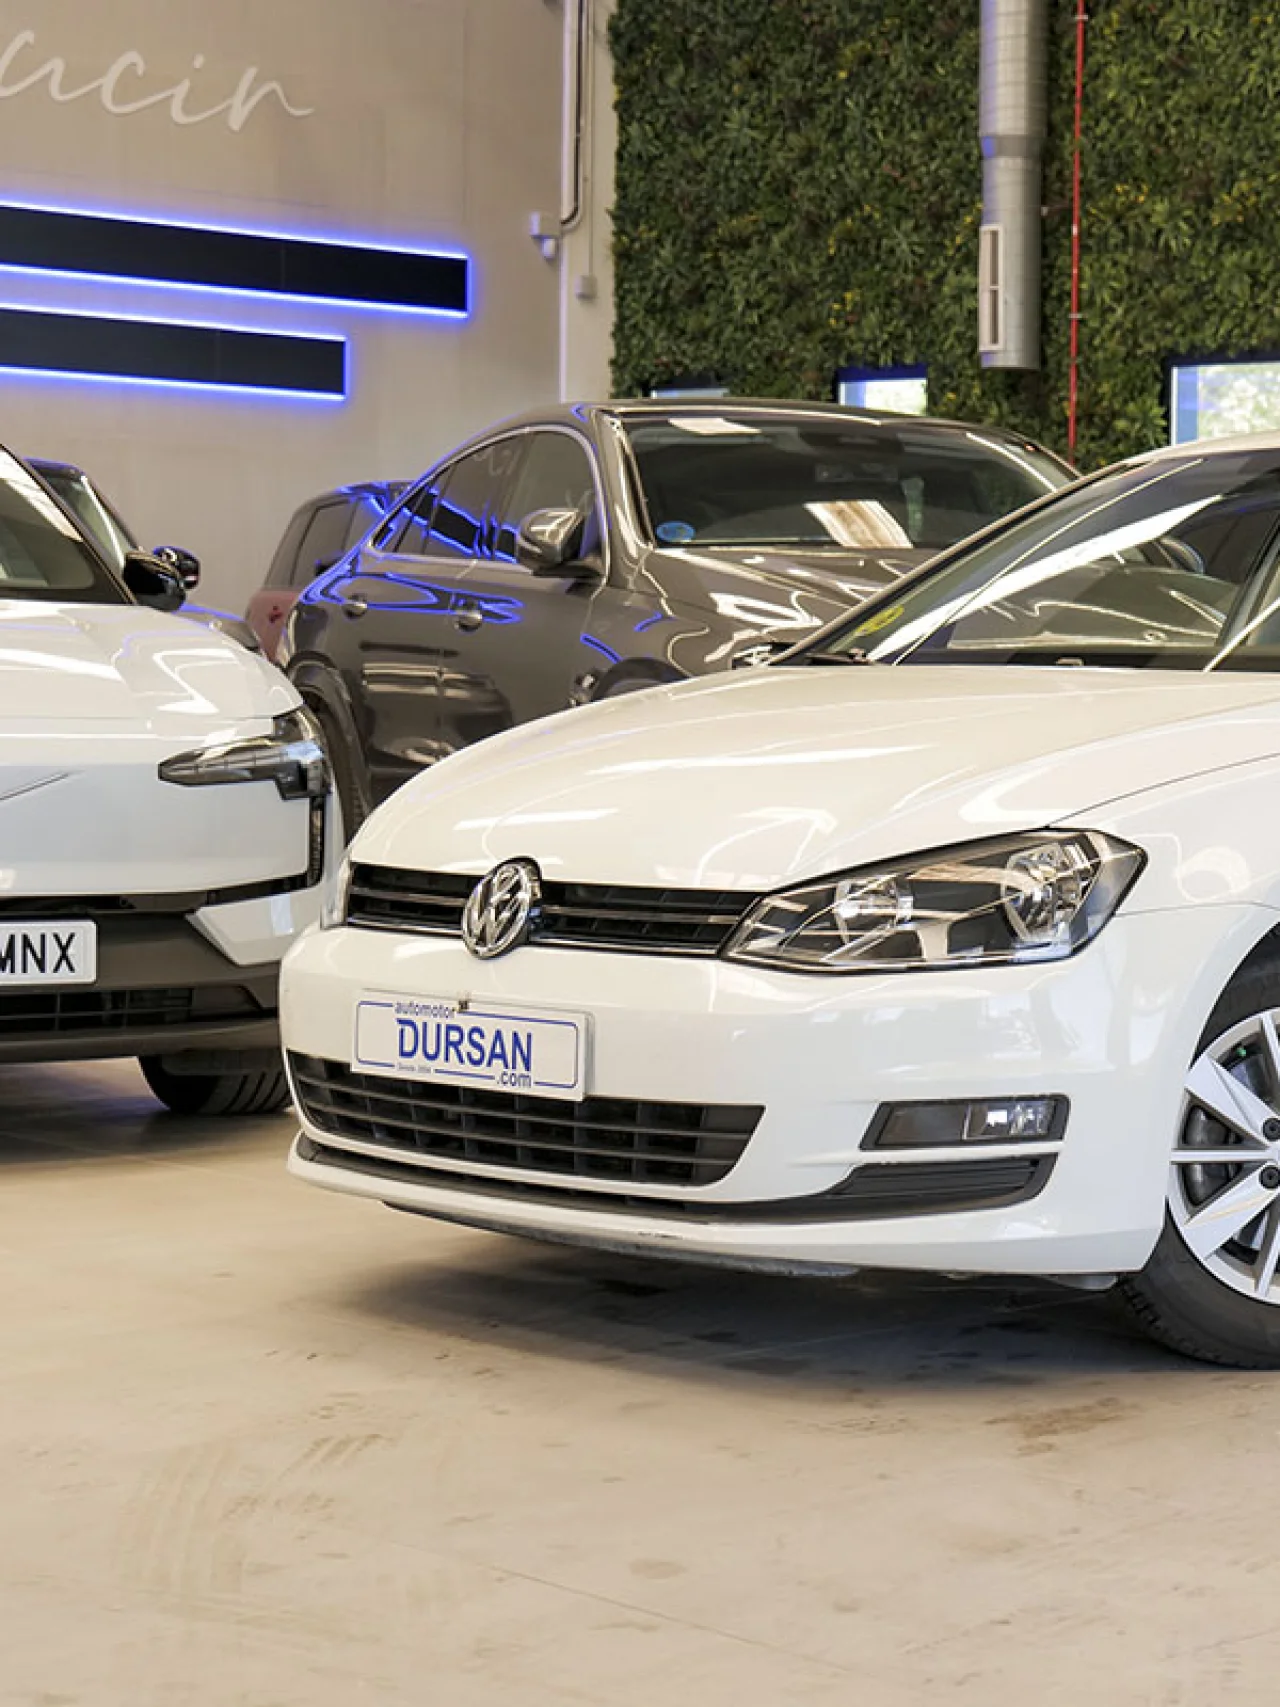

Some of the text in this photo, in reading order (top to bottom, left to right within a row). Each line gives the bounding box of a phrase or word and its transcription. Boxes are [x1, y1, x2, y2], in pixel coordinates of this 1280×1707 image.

[395, 1002, 456, 1019] automotor
[396, 1018, 532, 1072] DURSAN
[496, 1071, 532, 1089] .com
